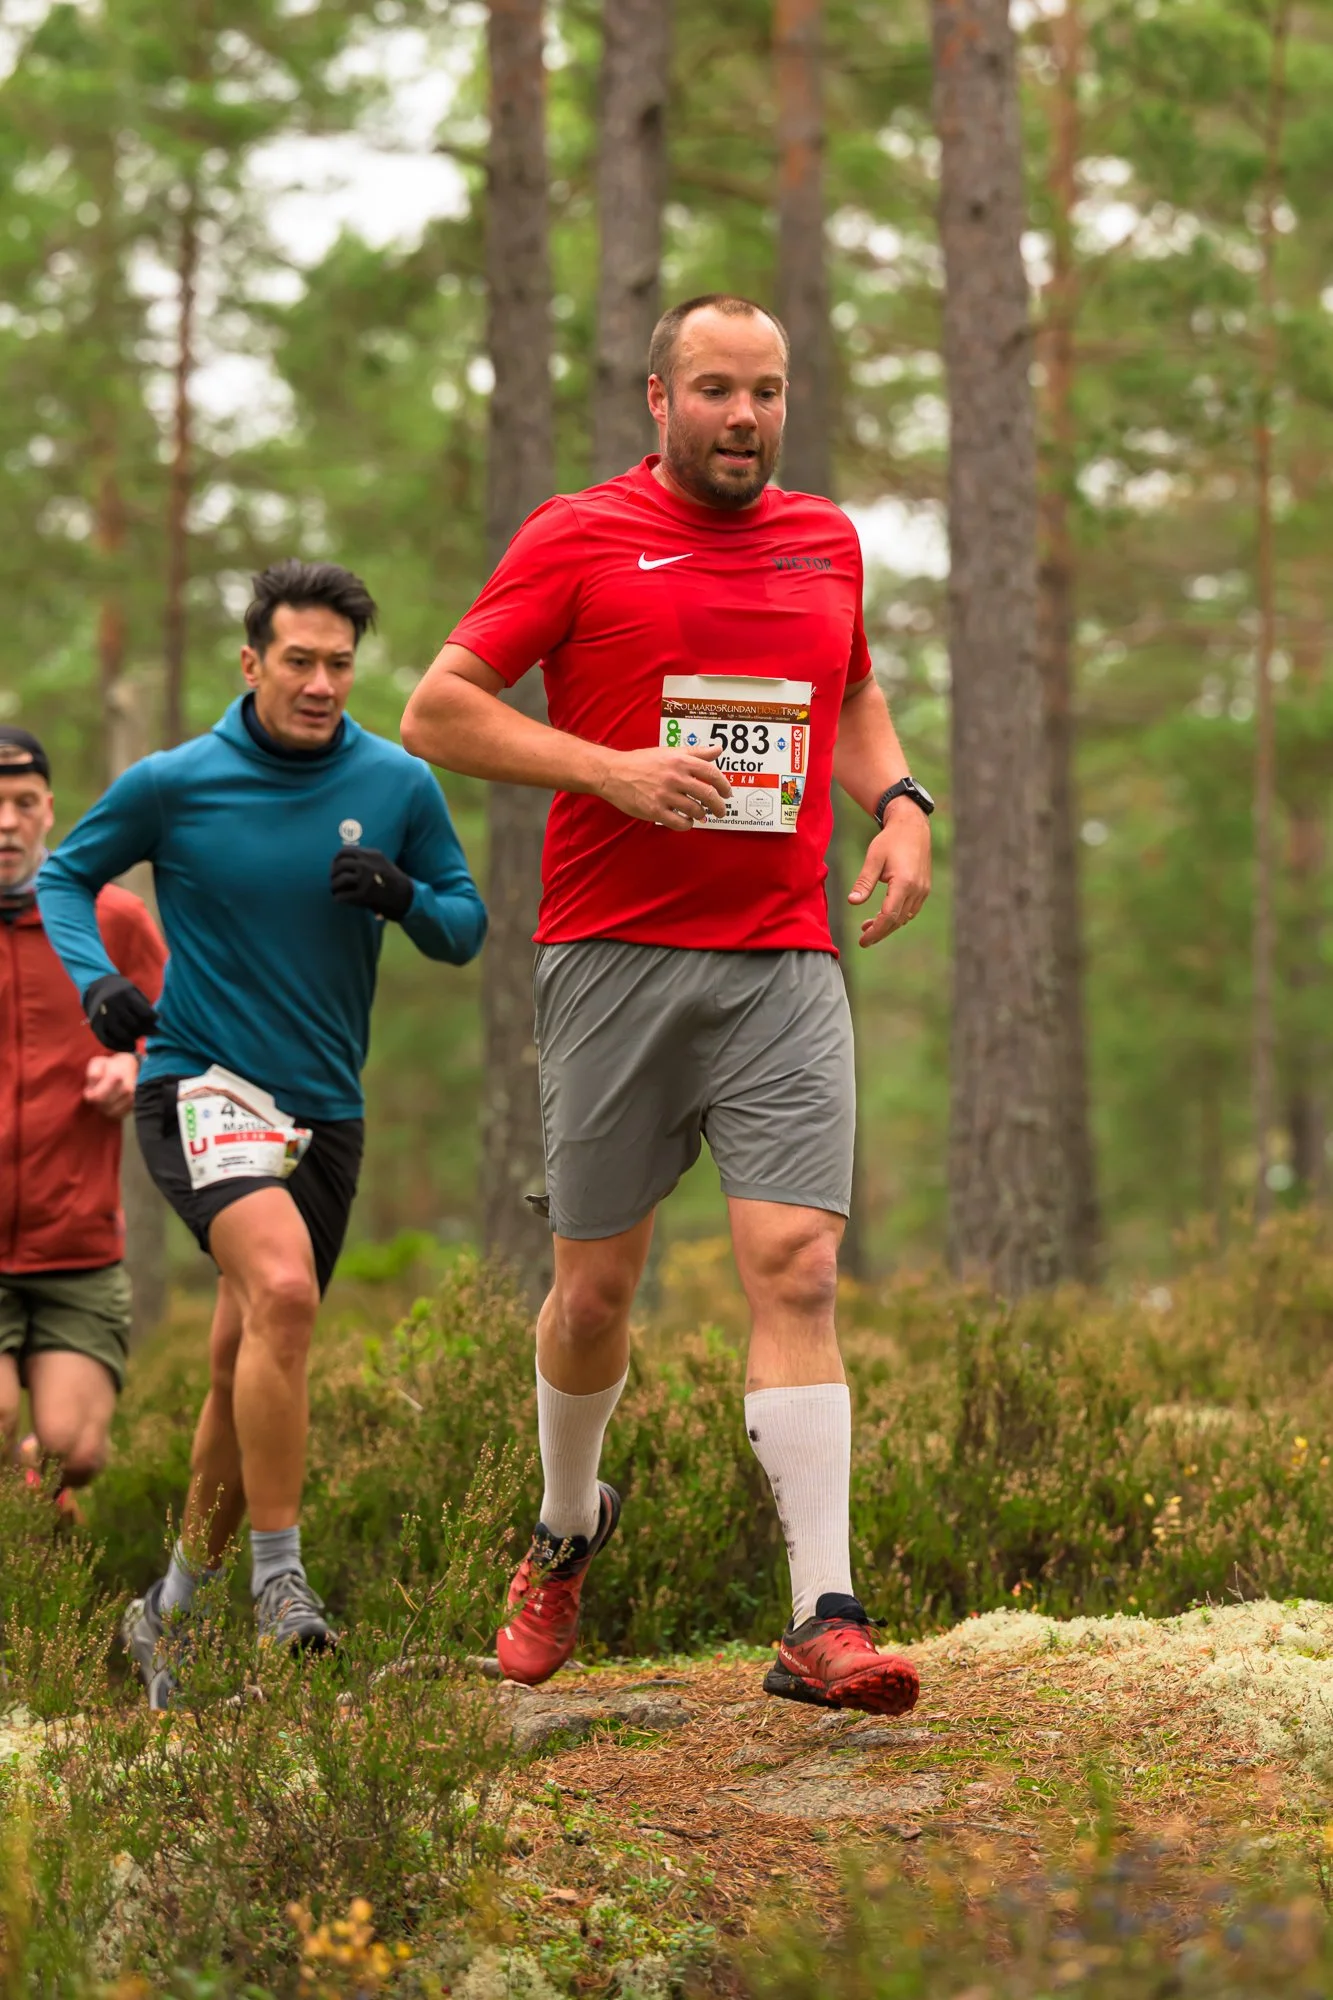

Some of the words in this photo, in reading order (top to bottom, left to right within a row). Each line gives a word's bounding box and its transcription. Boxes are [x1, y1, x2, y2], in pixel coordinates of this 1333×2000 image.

[771, 557, 832, 571] VICTOR
[709, 723, 770, 755] 583
[715, 757, 764, 772] Victor
[740, 775, 755, 784] KM
